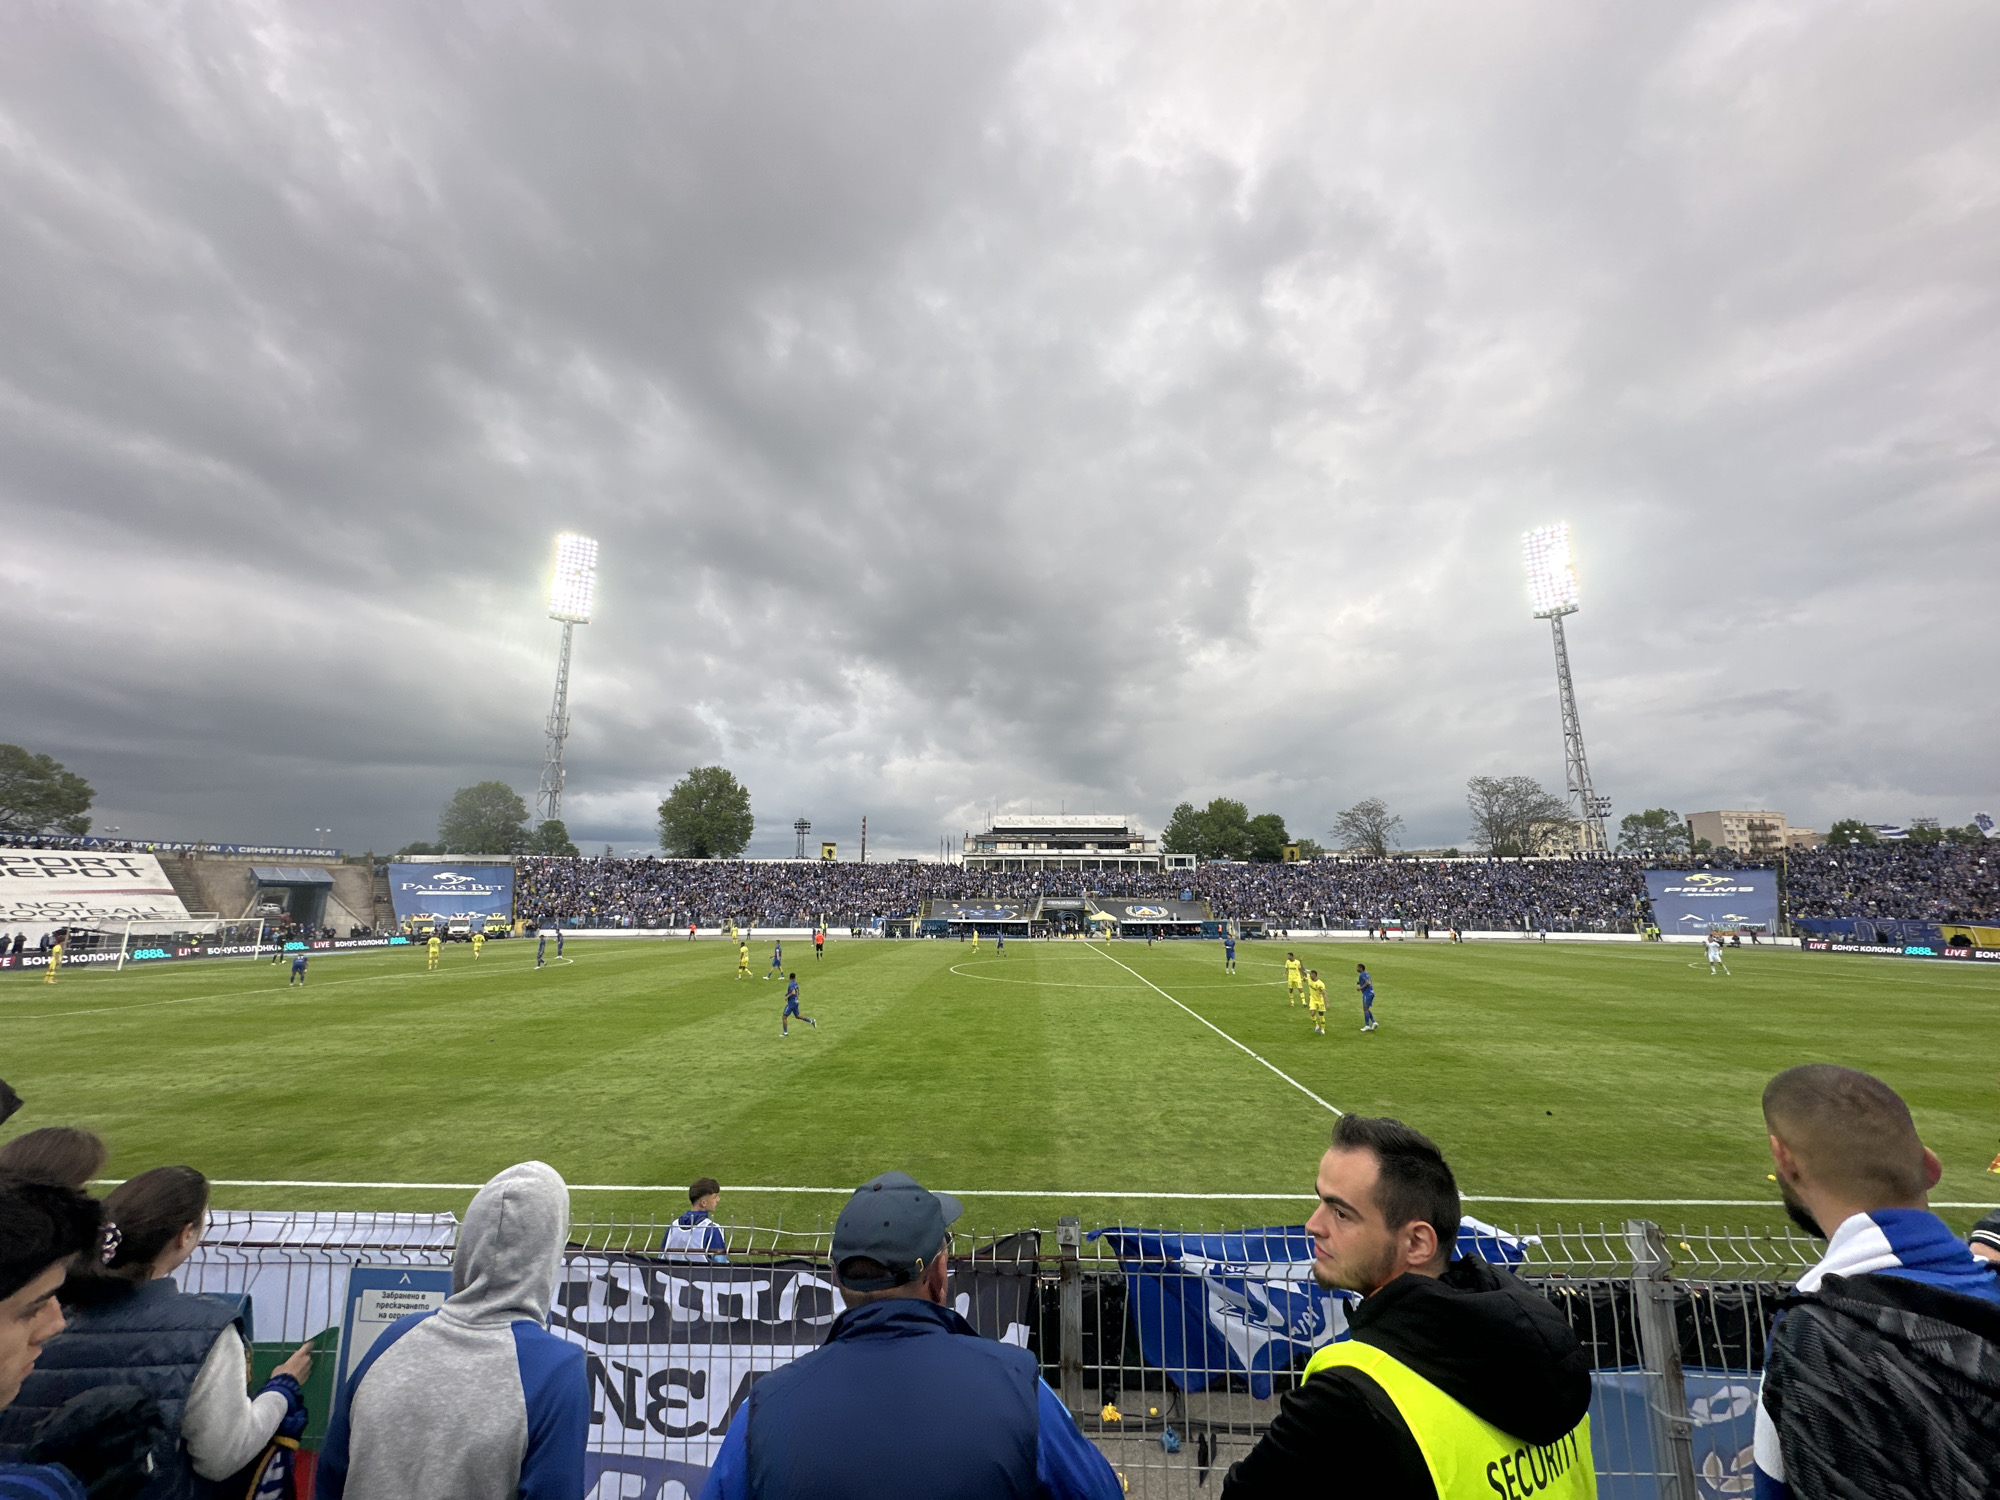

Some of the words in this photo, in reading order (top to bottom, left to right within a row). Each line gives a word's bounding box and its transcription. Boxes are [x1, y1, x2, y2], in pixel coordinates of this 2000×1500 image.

[295, 848, 336, 857] АТАКА!
[0, 867, 145, 878] EPOT
[401, 882, 467, 891] PALMS
[15, 901, 88, 909] NOT
[314, 941, 330, 949] LIVE
[334, 940, 358, 948] БОНУС
[1809, 942, 1828, 950] LIVE
[1831, 944, 1860, 952] БОНУС
[1860, 945, 1903, 954] КОЛОНКА
[1944, 948, 1969, 957] LIVE
[382, 1291, 419, 1300] Забранено
[376, 1302, 429, 1310] прескачането
[1486, 1428, 1579, 1500] SECURITY
